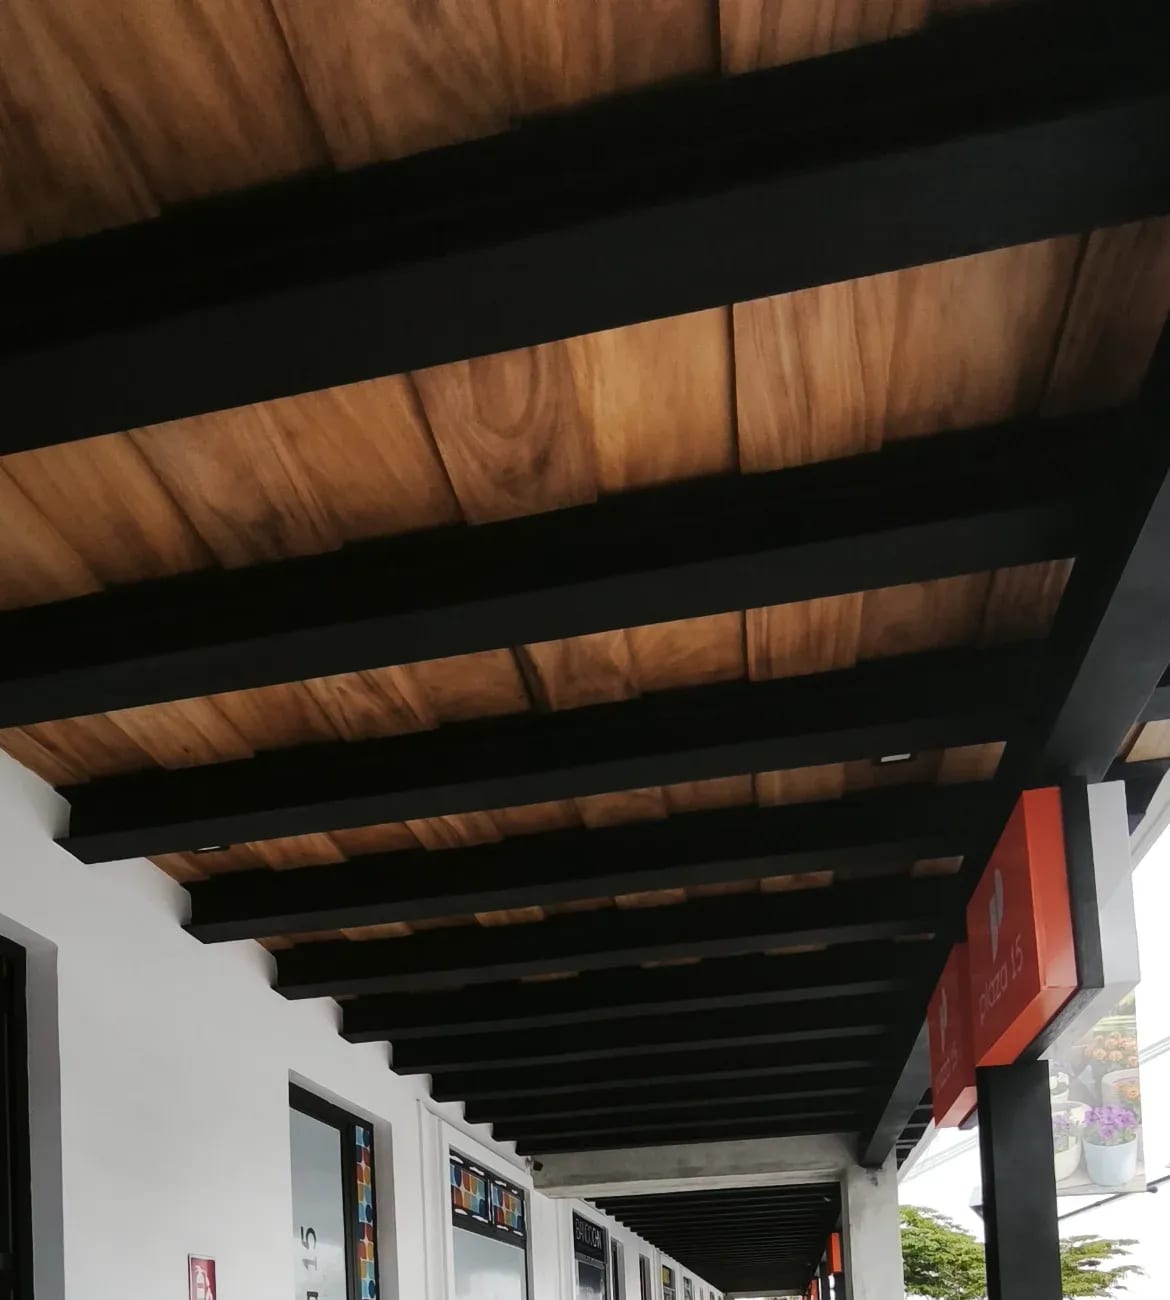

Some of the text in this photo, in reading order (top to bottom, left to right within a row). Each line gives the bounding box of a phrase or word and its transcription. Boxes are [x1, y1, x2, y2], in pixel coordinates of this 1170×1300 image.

[979, 932, 1024, 1025] plaza 15
[300, 1225, 318, 1272] 15
